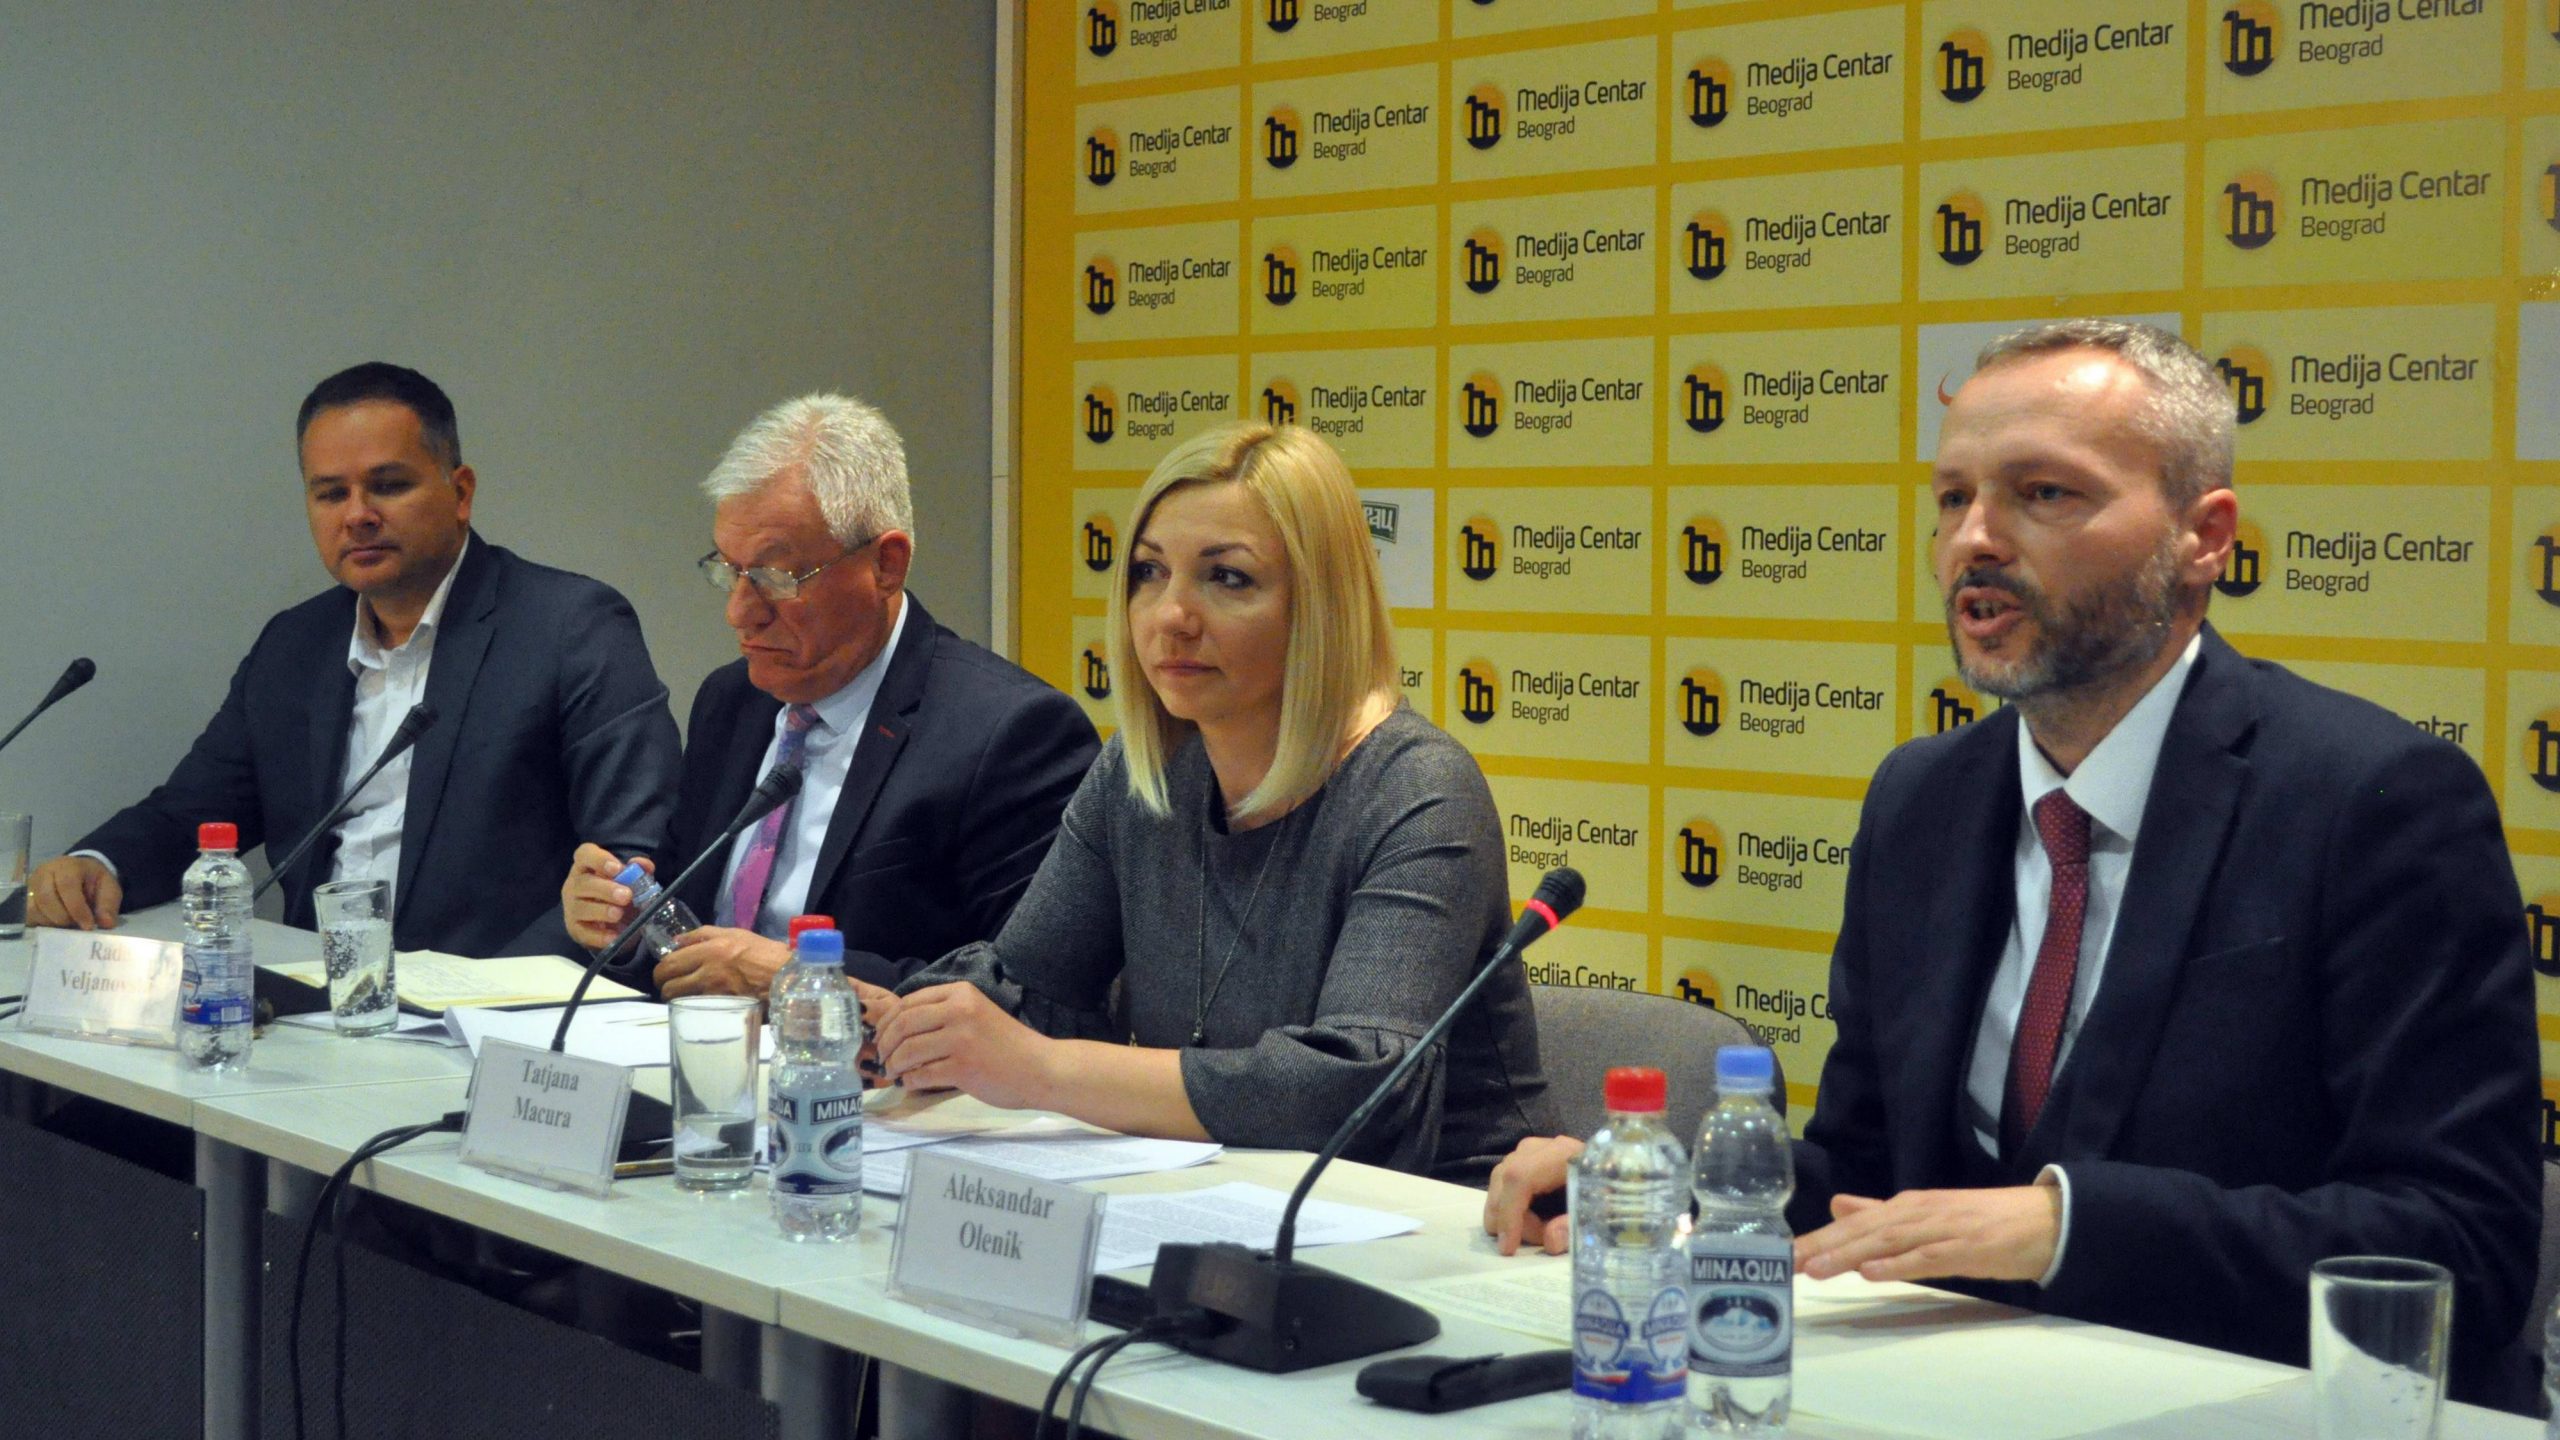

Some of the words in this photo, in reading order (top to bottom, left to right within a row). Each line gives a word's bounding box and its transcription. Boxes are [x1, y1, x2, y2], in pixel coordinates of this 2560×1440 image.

[1130, 0, 1181, 24] Medija
[1313, 0, 1368, 23] Beograd
[2299, 0, 2391, 32] Medija
[1130, 24, 1178, 48] Beograd
[2007, 27, 2089, 62] Medija
[2093, 21, 2174, 52] Centar
[2298, 34, 2383, 65] Beograd
[1747, 57, 1818, 90] Medija
[1822, 51, 1894, 80] Centar
[2007, 63, 2083, 93] Beograd
[1516, 84, 1580, 115] Medija
[1583, 79, 1647, 106] Centar
[1747, 90, 1813, 118] Beograd
[1313, 107, 1371, 137] Medija
[1373, 104, 1430, 129] Centar
[1516, 115, 1576, 142] Beograd
[1129, 128, 1180, 155] Medija
[1182, 125, 1233, 148] Centar
[1313, 138, 1366, 162] Beograd
[1129, 157, 1177, 179] Beograd
[2301, 173, 2393, 210] Medija
[2399, 170, 2491, 200] Centar
[2005, 194, 2086, 230] Medija
[2091, 191, 2172, 220] Centar
[1745, 213, 1817, 246] Medija
[1821, 210, 1892, 238] Centar
[2301, 212, 2386, 241] Beograd
[1515, 231, 1579, 262] Medija
[1582, 228, 1646, 254] Centar
[2005, 231, 2080, 259] Beograd
[1128, 259, 1180, 287] Medija
[1181, 257, 1232, 280] Centar
[1312, 248, 1370, 277] Medija
[1372, 245, 1428, 270] Centar
[1745, 247, 1812, 274] Beograd
[1312, 279, 1365, 301] Beograd
[1515, 263, 1574, 288] Beograd
[1128, 289, 1176, 310] Beograd
[1743, 370, 1815, 403] Medija
[1819, 368, 1890, 396] Centar
[2290, 353, 2382, 390] Medija
[2388, 352, 2479, 382] Centar
[1127, 391, 1178, 418] Medija
[1180, 389, 1230, 413] Centar
[1310, 385, 1368, 414] Medija
[1371, 384, 1427, 408] Centar
[1514, 378, 1578, 409] Medija
[1581, 377, 1644, 402] Centar
[2290, 392, 2374, 421] Beograd
[1127, 420, 1175, 441] Beograd
[1311, 415, 1364, 438] Beograd
[1514, 410, 1573, 434] Beograd
[1743, 404, 1809, 430] Beograd
[1512, 524, 1576, 556] Medija
[1579, 524, 1643, 550] Centar
[1741, 525, 1813, 558] Medija
[1816, 525, 1888, 553] Centar
[2286, 530, 2377, 568] Medija
[2383, 531, 2474, 563] Centar
[1512, 555, 1571, 580] Beograd
[1741, 558, 1807, 584] Beograd
[2285, 568, 2370, 598] Beograd
[1401, 666, 1424, 688] tar
[1511, 669, 1575, 702] Medija
[1578, 671, 1641, 699] Centar
[1739, 678, 1811, 713] Medija
[1814, 681, 1885, 711] Centar
[1511, 700, 1570, 726] Beograd
[1739, 711, 1805, 738] Beograd
[2414, 715, 2469, 743] tar
[1509, 813, 1573, 847] Medija
[1576, 818, 1639, 847] Centar
[1510, 844, 1569, 871] Beograd
[1737, 831, 1809, 868] Medija
[1813, 838, 1850, 865] Cen
[1737, 864, 1803, 892] Beograd
[89, 940, 130, 962] Rad
[1523, 962, 1571, 986] edija
[1735, 983, 1806, 1022] Medija
[522, 1059, 580, 1093] Tatjana
[513, 1096, 573, 1129] Macura
[816, 1095, 863, 1121] MINA
[943, 1172, 1055, 1219] Aleksandar
[959, 1220, 1023, 1260] Olenik
[1694, 1257, 1787, 1283] MINAQUA
